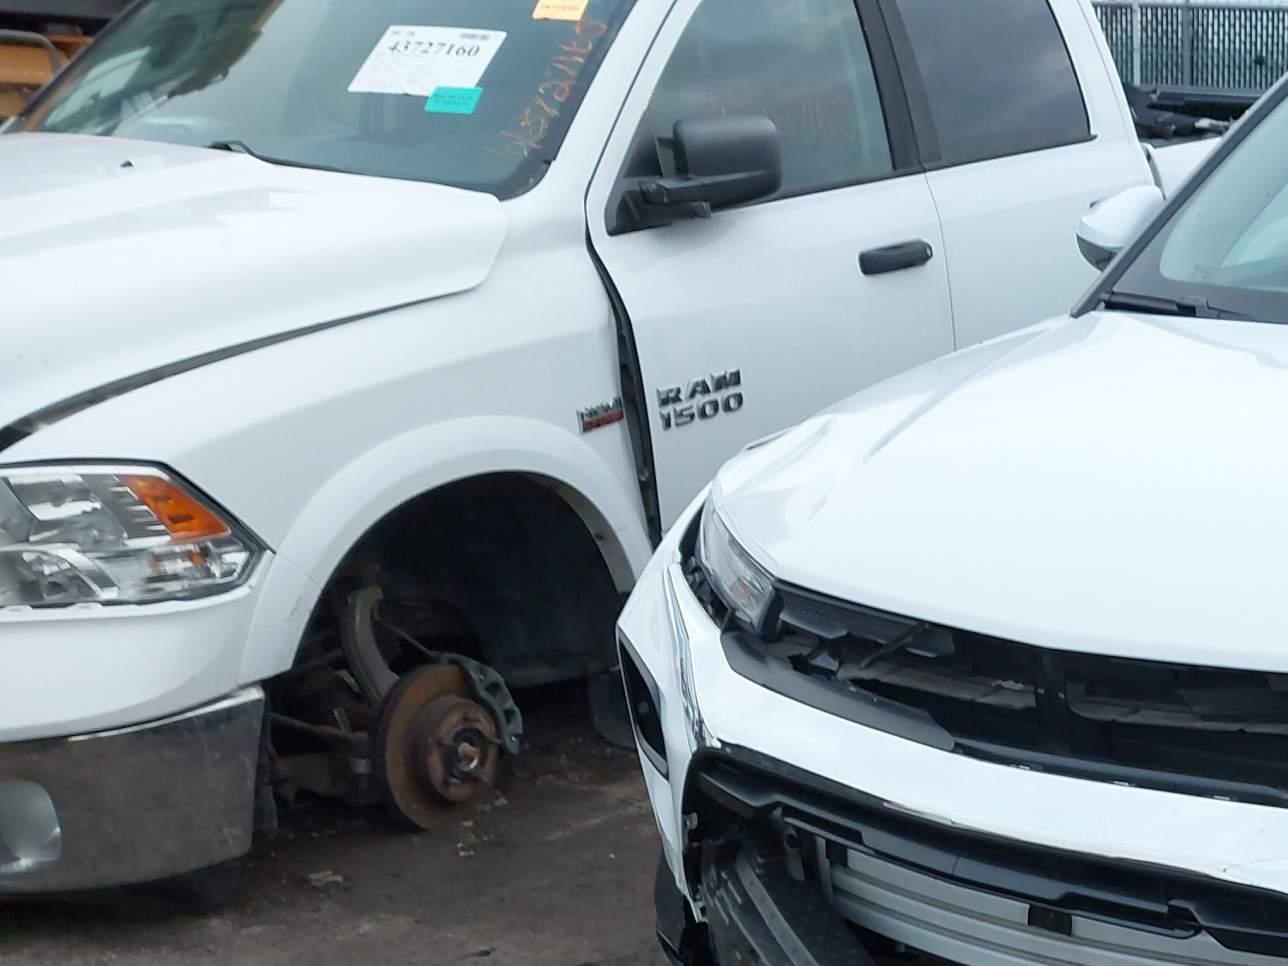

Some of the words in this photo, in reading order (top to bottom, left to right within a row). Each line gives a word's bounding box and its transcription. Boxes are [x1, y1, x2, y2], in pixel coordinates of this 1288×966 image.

[387, 40, 481, 57] 43727160
[656, 369, 742, 407] RAM
[659, 391, 744, 431] 1500
